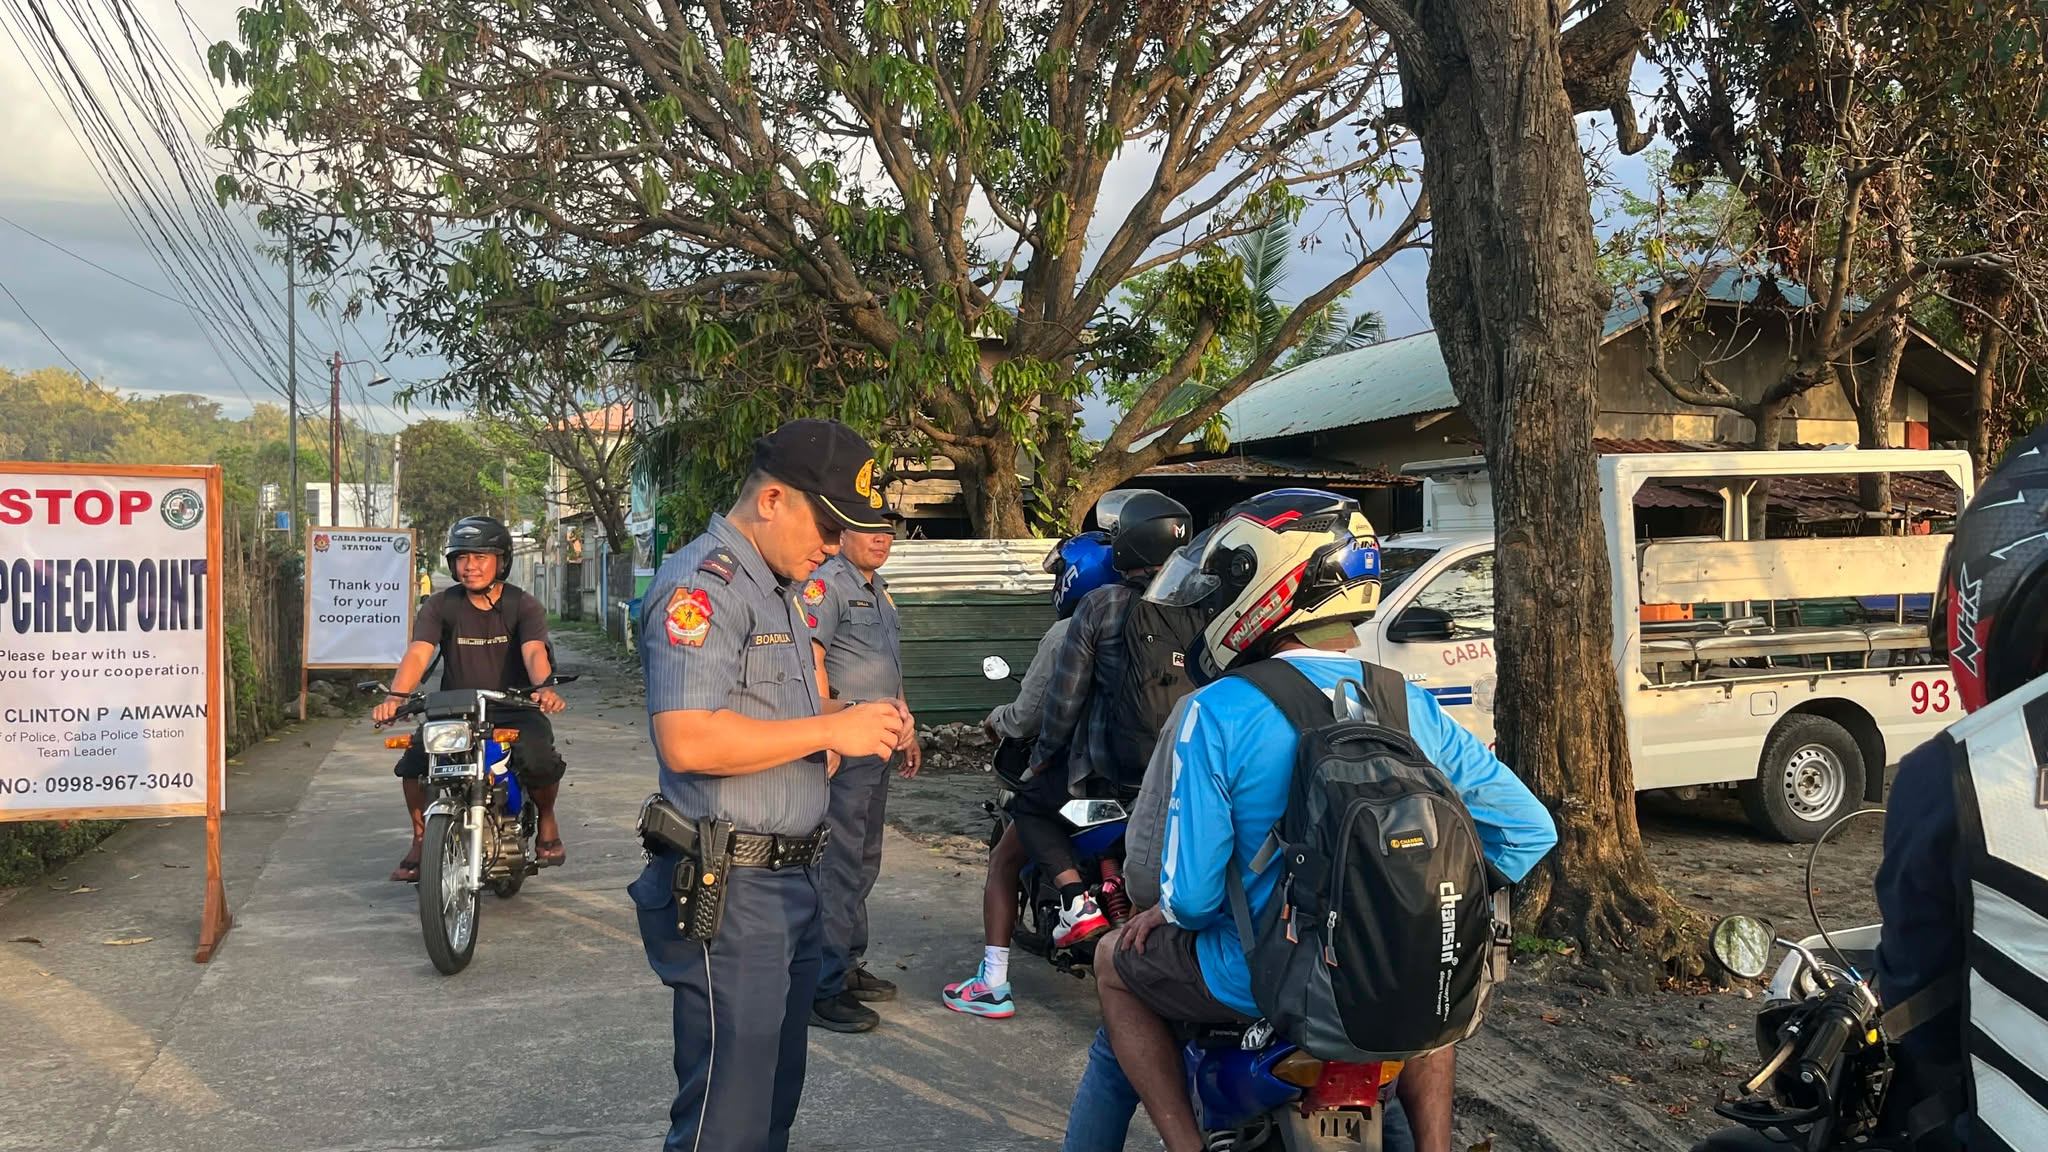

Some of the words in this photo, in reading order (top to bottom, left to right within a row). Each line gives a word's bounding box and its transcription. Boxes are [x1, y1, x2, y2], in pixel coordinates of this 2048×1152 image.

[0, 488, 153, 526] STOP
[331, 534, 358, 542] CABA
[358, 534, 393, 543] POLICE
[329, 578, 371, 590] Thank
[375, 580, 400, 593] you
[333, 595, 353, 607] for
[356, 597, 388, 609] your
[319, 612, 400, 625] cooperation
[1951, 562, 1982, 678] NHK
[52, 650, 87, 661] bear
[92, 649, 126, 660] with
[132, 649, 156, 659] us.
[1442, 641, 1492, 666] CABA
[0, 669, 27, 681] you
[32, 667, 55, 679] for
[61, 668, 99, 681] your
[1911, 679, 1956, 714] 93
[4, 708, 90, 723] CLINTON
[120, 704, 208, 721] AMAWAN
[5, 732, 16, 742] of
[20, 731, 60, 743] Police,
[64, 731, 97, 742] Caba
[101, 729, 139, 741] Police
[142, 728, 185, 739] Station
[37, 747, 70, 758] Team
[74, 746, 117, 757] Leader
[0, 778, 37, 794] NO:
[45, 773, 194, 793] 0998-967-3040
